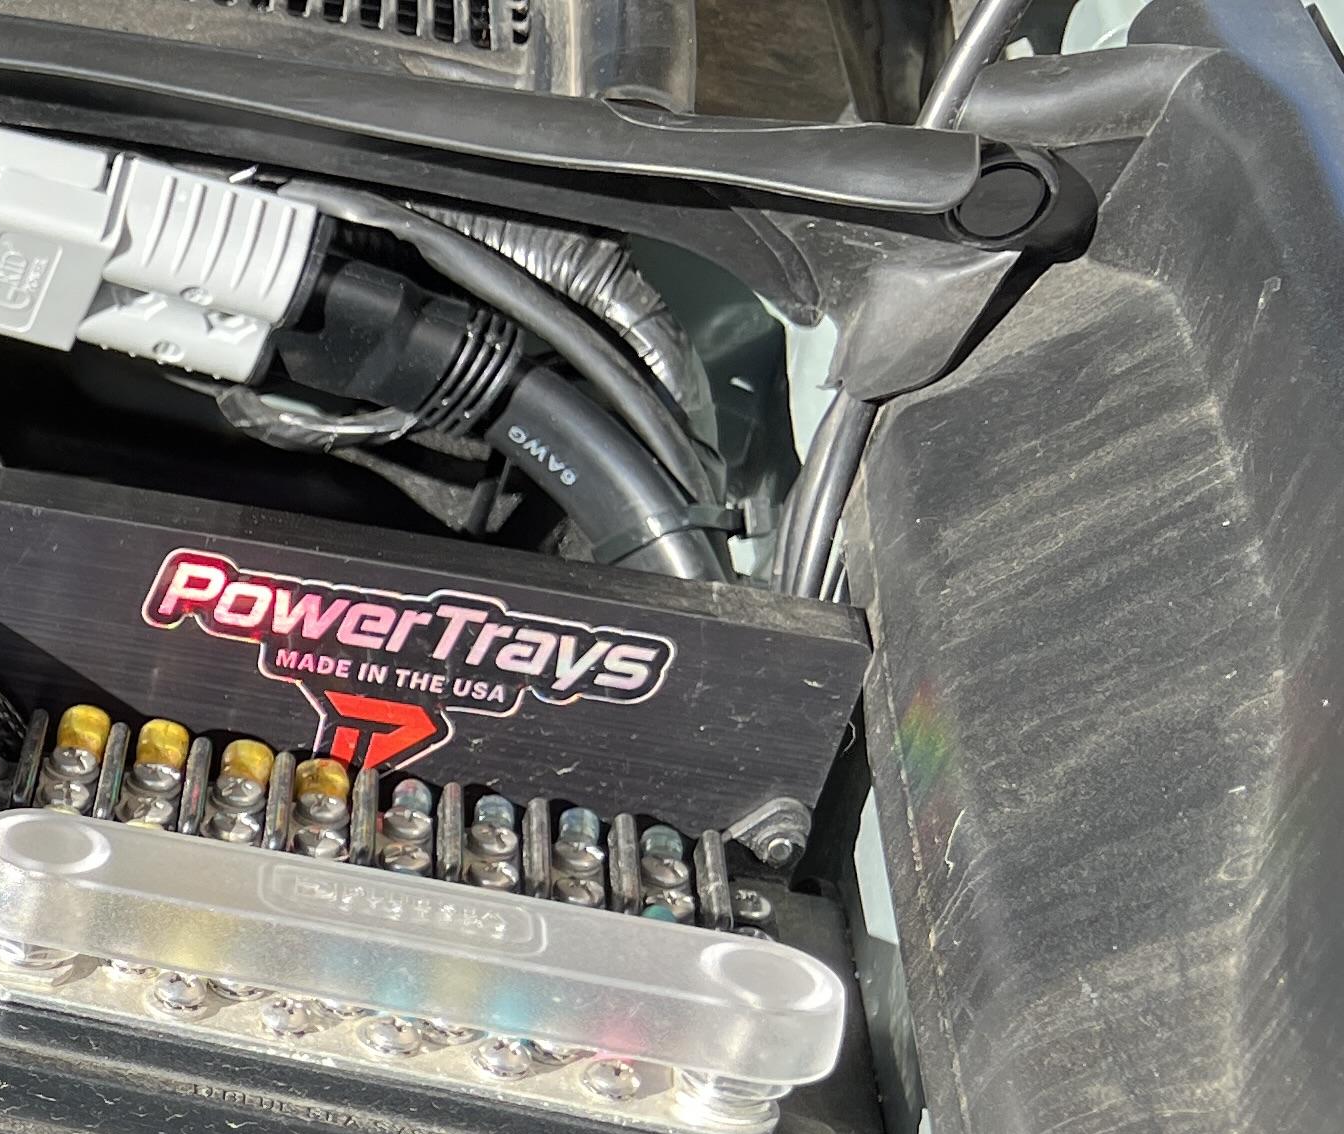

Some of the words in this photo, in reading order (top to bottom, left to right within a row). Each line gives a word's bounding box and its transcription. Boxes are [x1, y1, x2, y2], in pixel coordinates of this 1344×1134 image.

[508, 426, 576, 486] 6AWG
[159, 560, 660, 691] PowerTrays
[275, 649, 351, 679] MADE
[357, 662, 389, 683] IN
[395, 668, 444, 695] THE
[452, 677, 506, 704] USA
